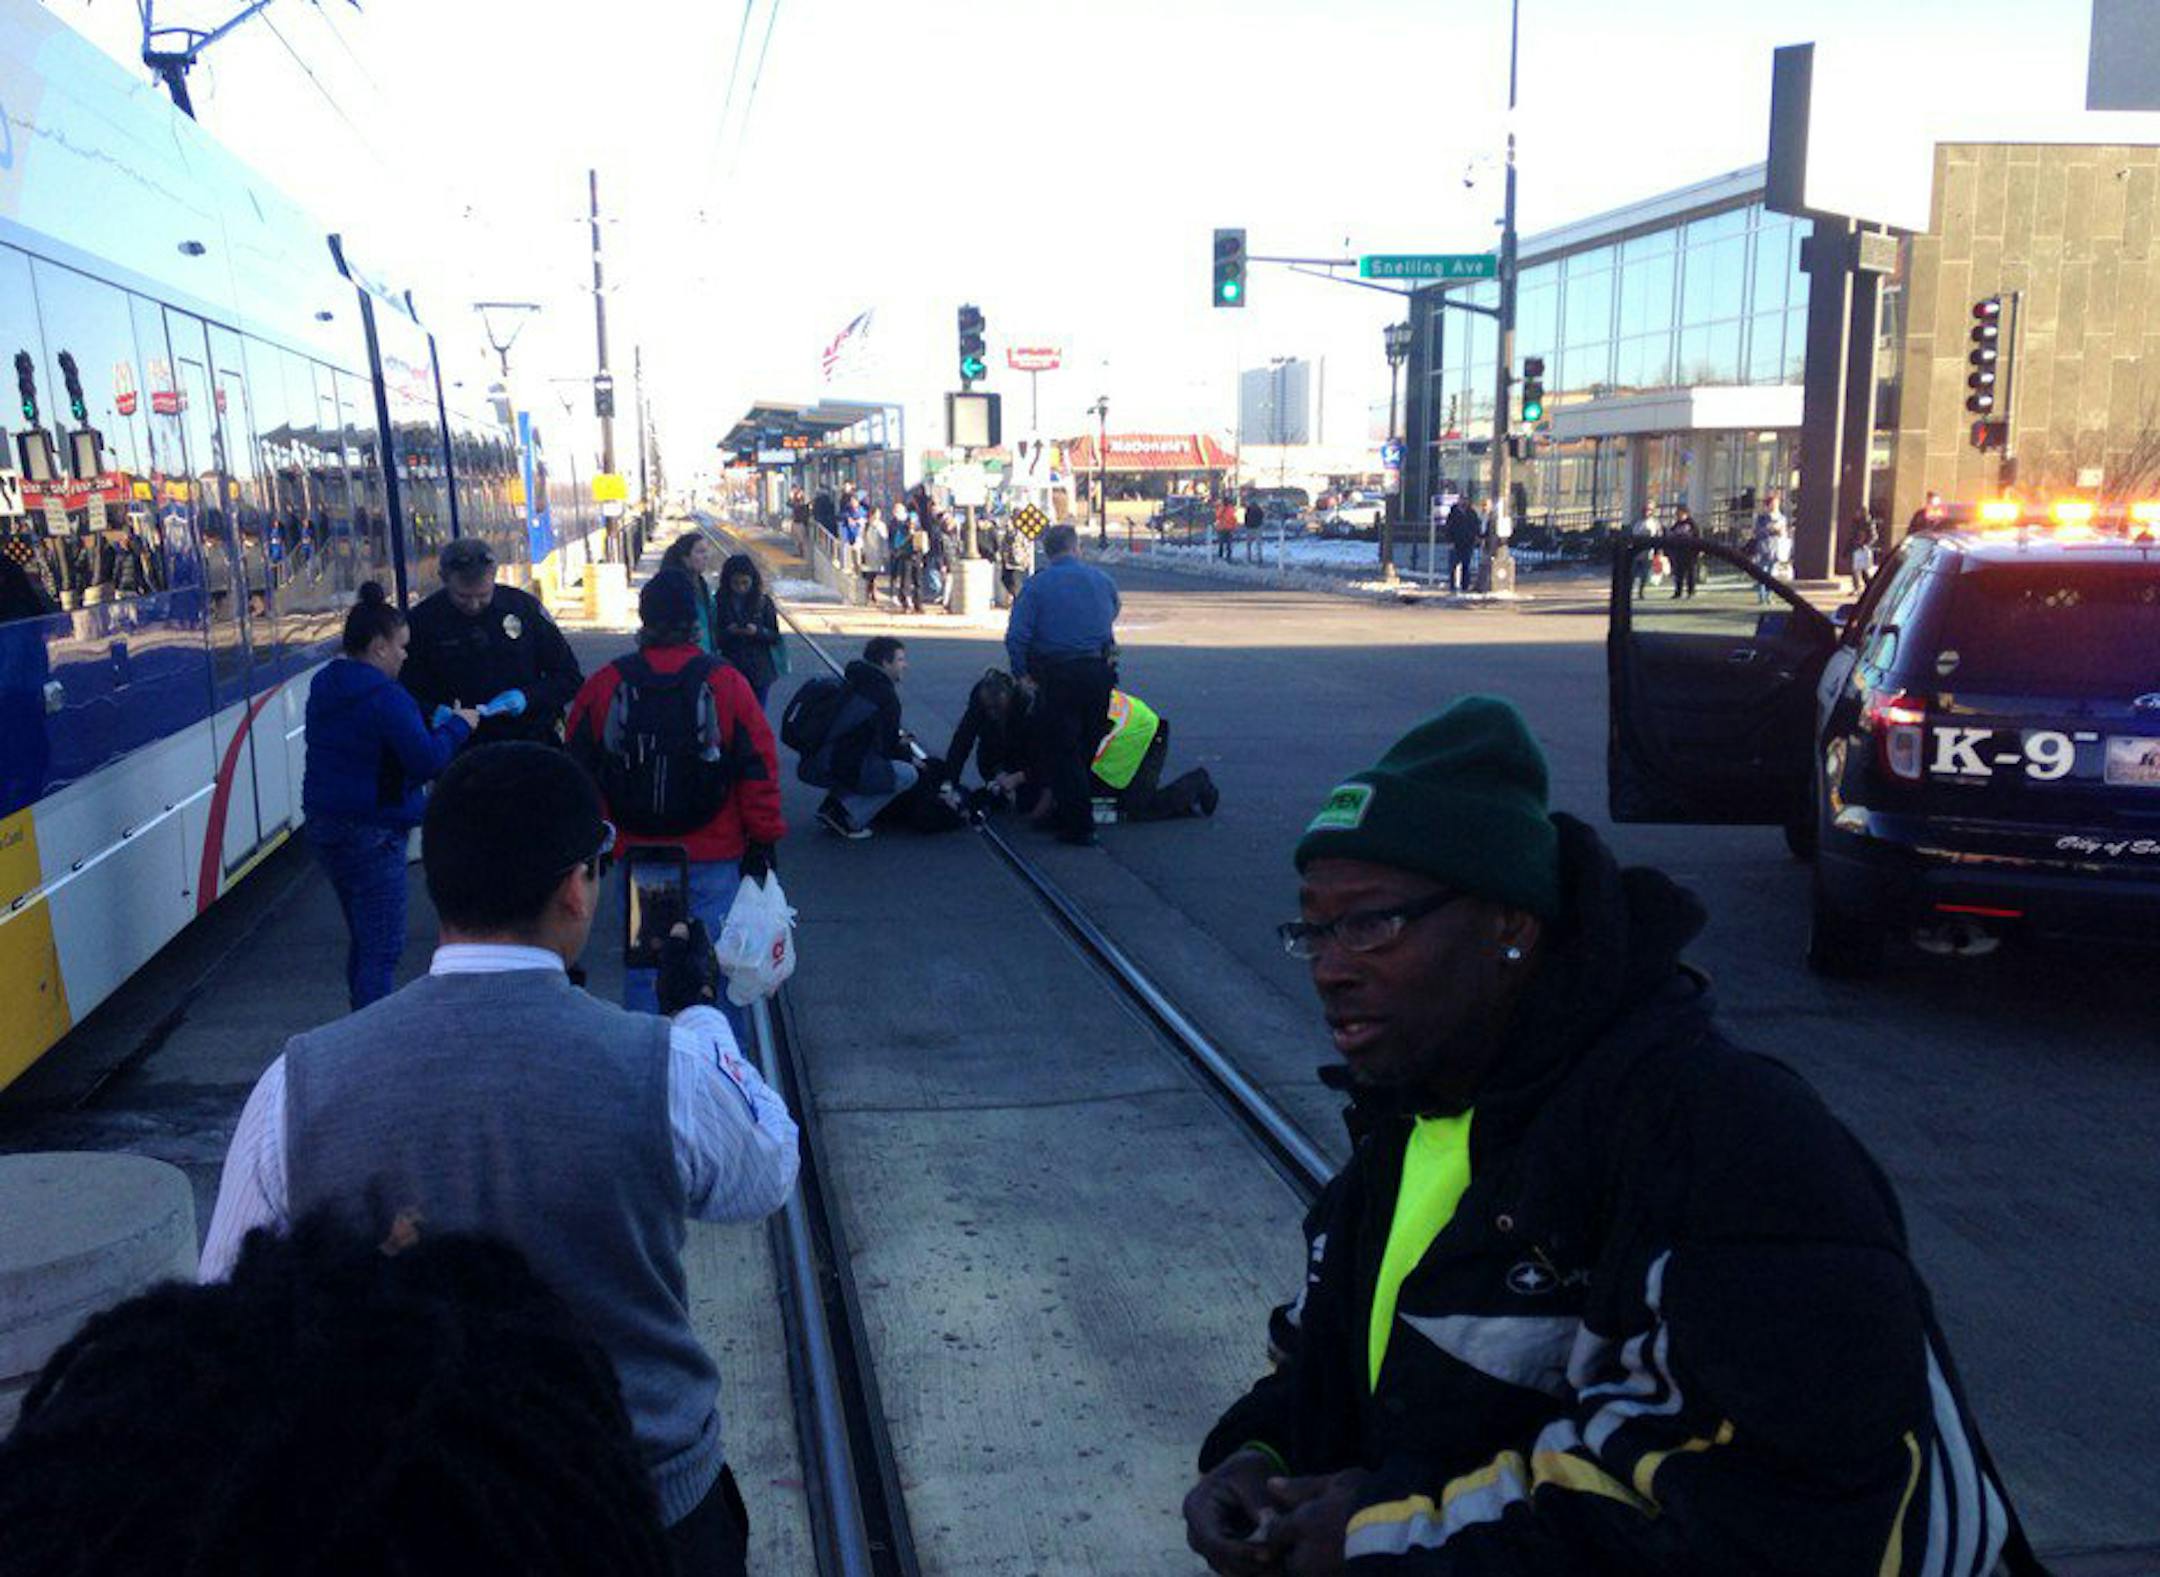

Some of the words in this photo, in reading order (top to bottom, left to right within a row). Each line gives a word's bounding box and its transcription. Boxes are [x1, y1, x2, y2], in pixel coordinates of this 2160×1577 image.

[1371, 259, 1443, 277] Snelling
[1453, 259, 1484, 274] Ave
[1930, 727, 2076, 780] K-9
[2056, 836, 2101, 854] City
[2103, 841, 2129, 856] of
